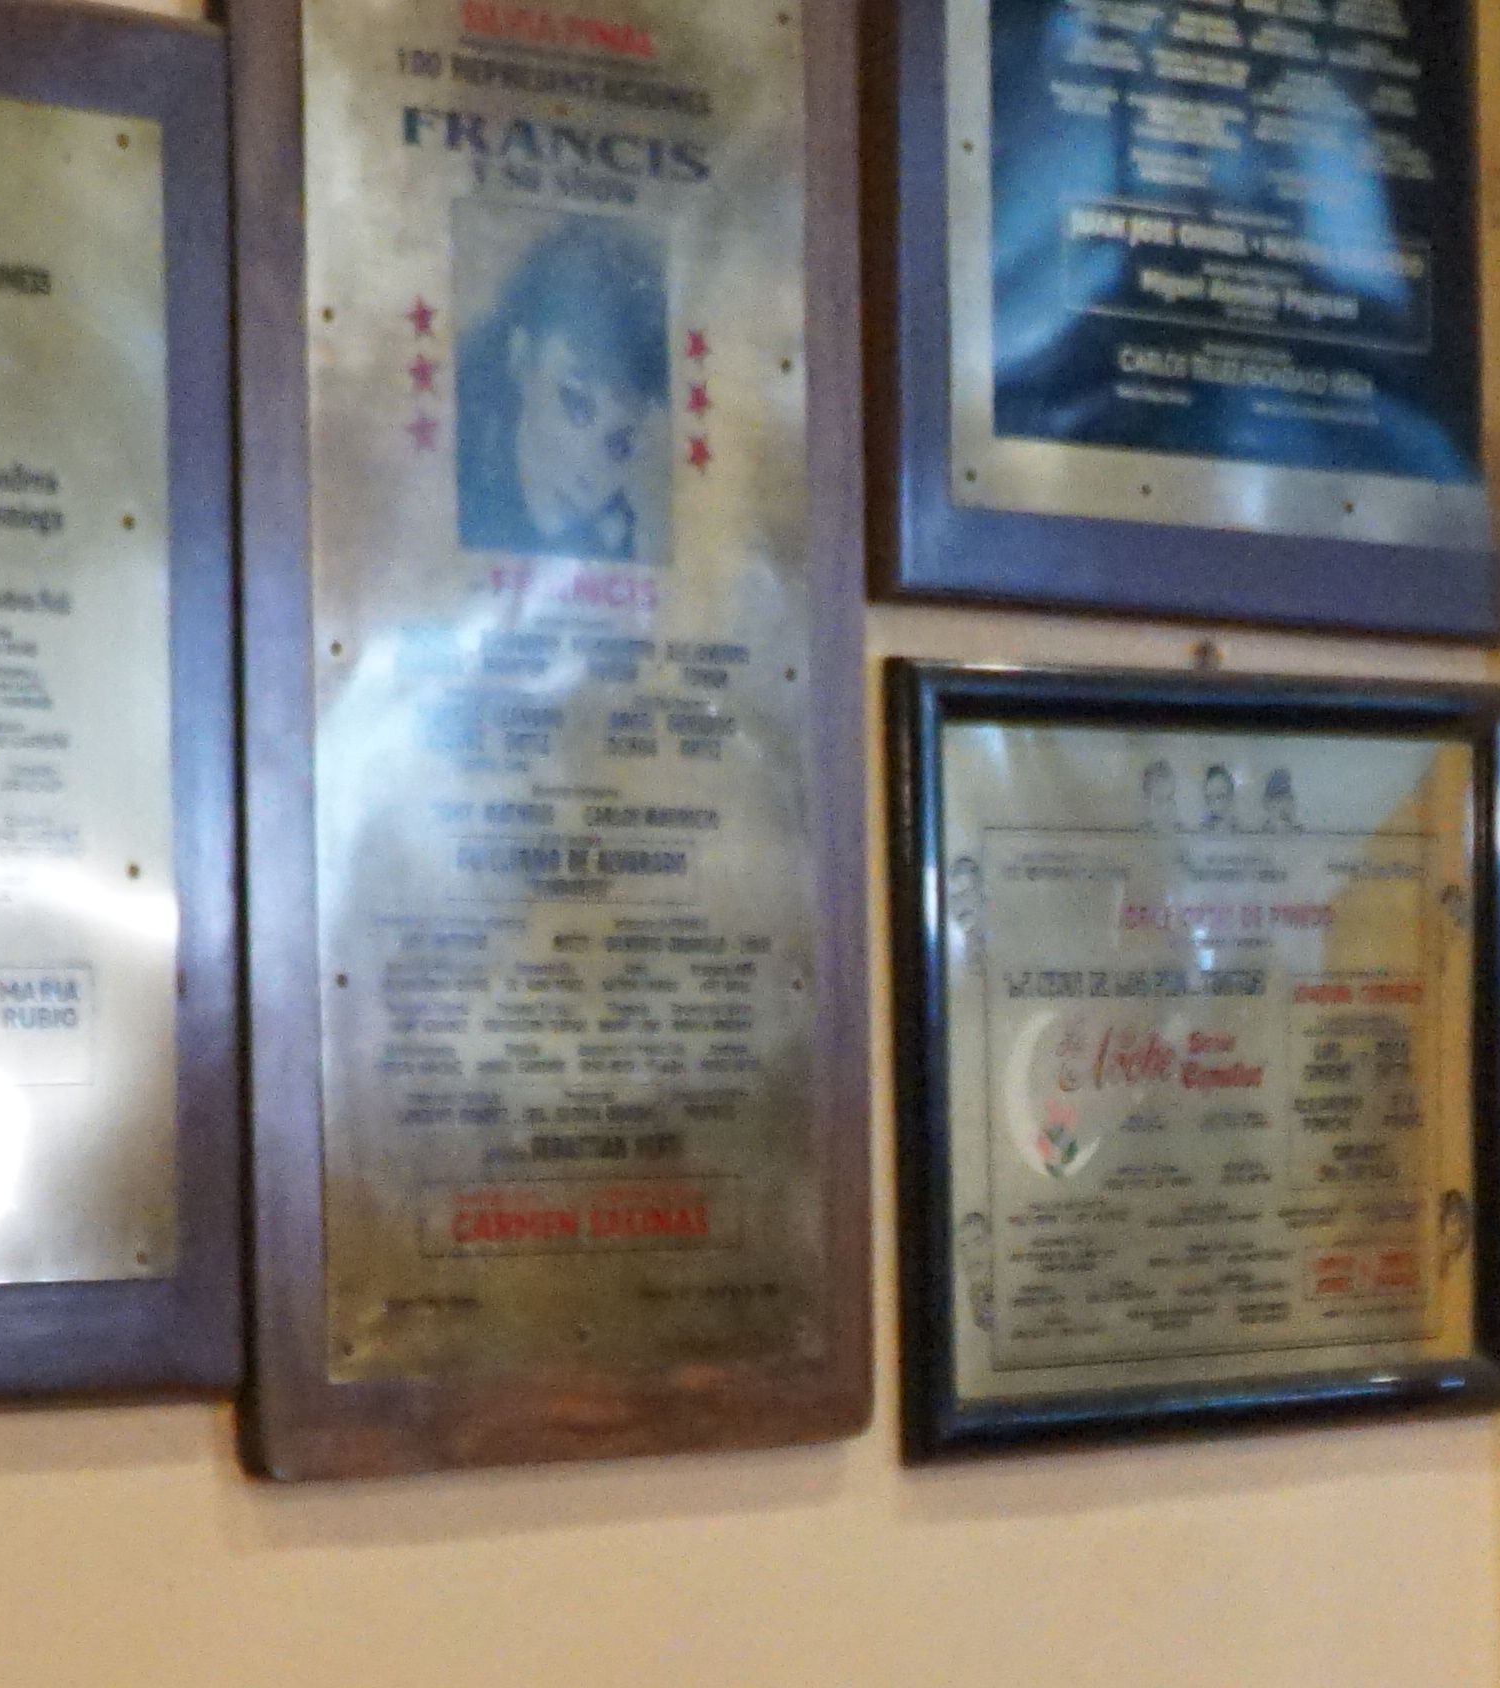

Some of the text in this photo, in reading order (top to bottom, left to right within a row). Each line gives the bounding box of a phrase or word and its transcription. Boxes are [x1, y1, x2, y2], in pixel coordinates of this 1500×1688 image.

[402, 104, 712, 185] FRANCIS
[489, 566, 660, 610] FRNCIS
[1, 1005, 81, 1031] RUBIO
[451, 1208, 580, 1245] CARMEN
